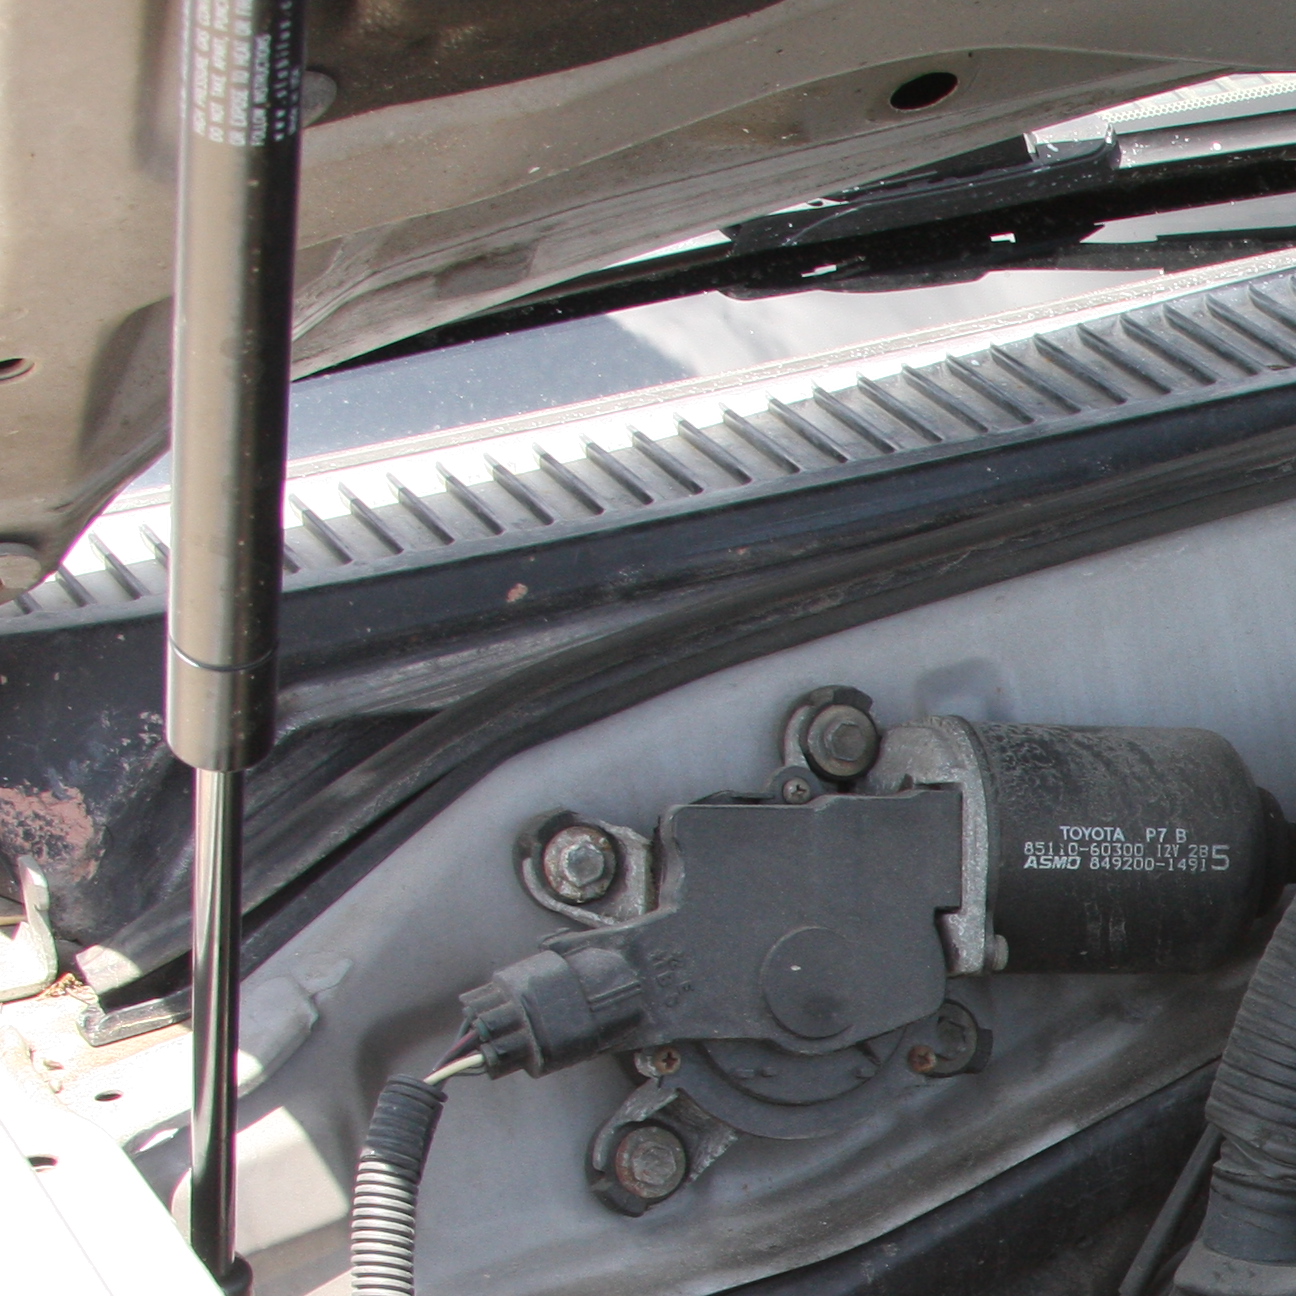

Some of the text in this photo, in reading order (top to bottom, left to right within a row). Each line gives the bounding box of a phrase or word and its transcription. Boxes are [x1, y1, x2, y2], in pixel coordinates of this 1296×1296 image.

[232, 40, 251, 67] HEAT
[231, 70, 250, 84] TO
[250, 34, 271, 147] FOLLOW INSTRUCTIONS
[230, 88, 249, 127] EXPOSE
[209, 126, 224, 143] DO
[229, 130, 246, 147] OR
[1060, 826, 1188, 843] TOYOTA P7 B
[1156, 844, 1180, 858] 12V
[1023, 855, 1082, 870] ASMO
